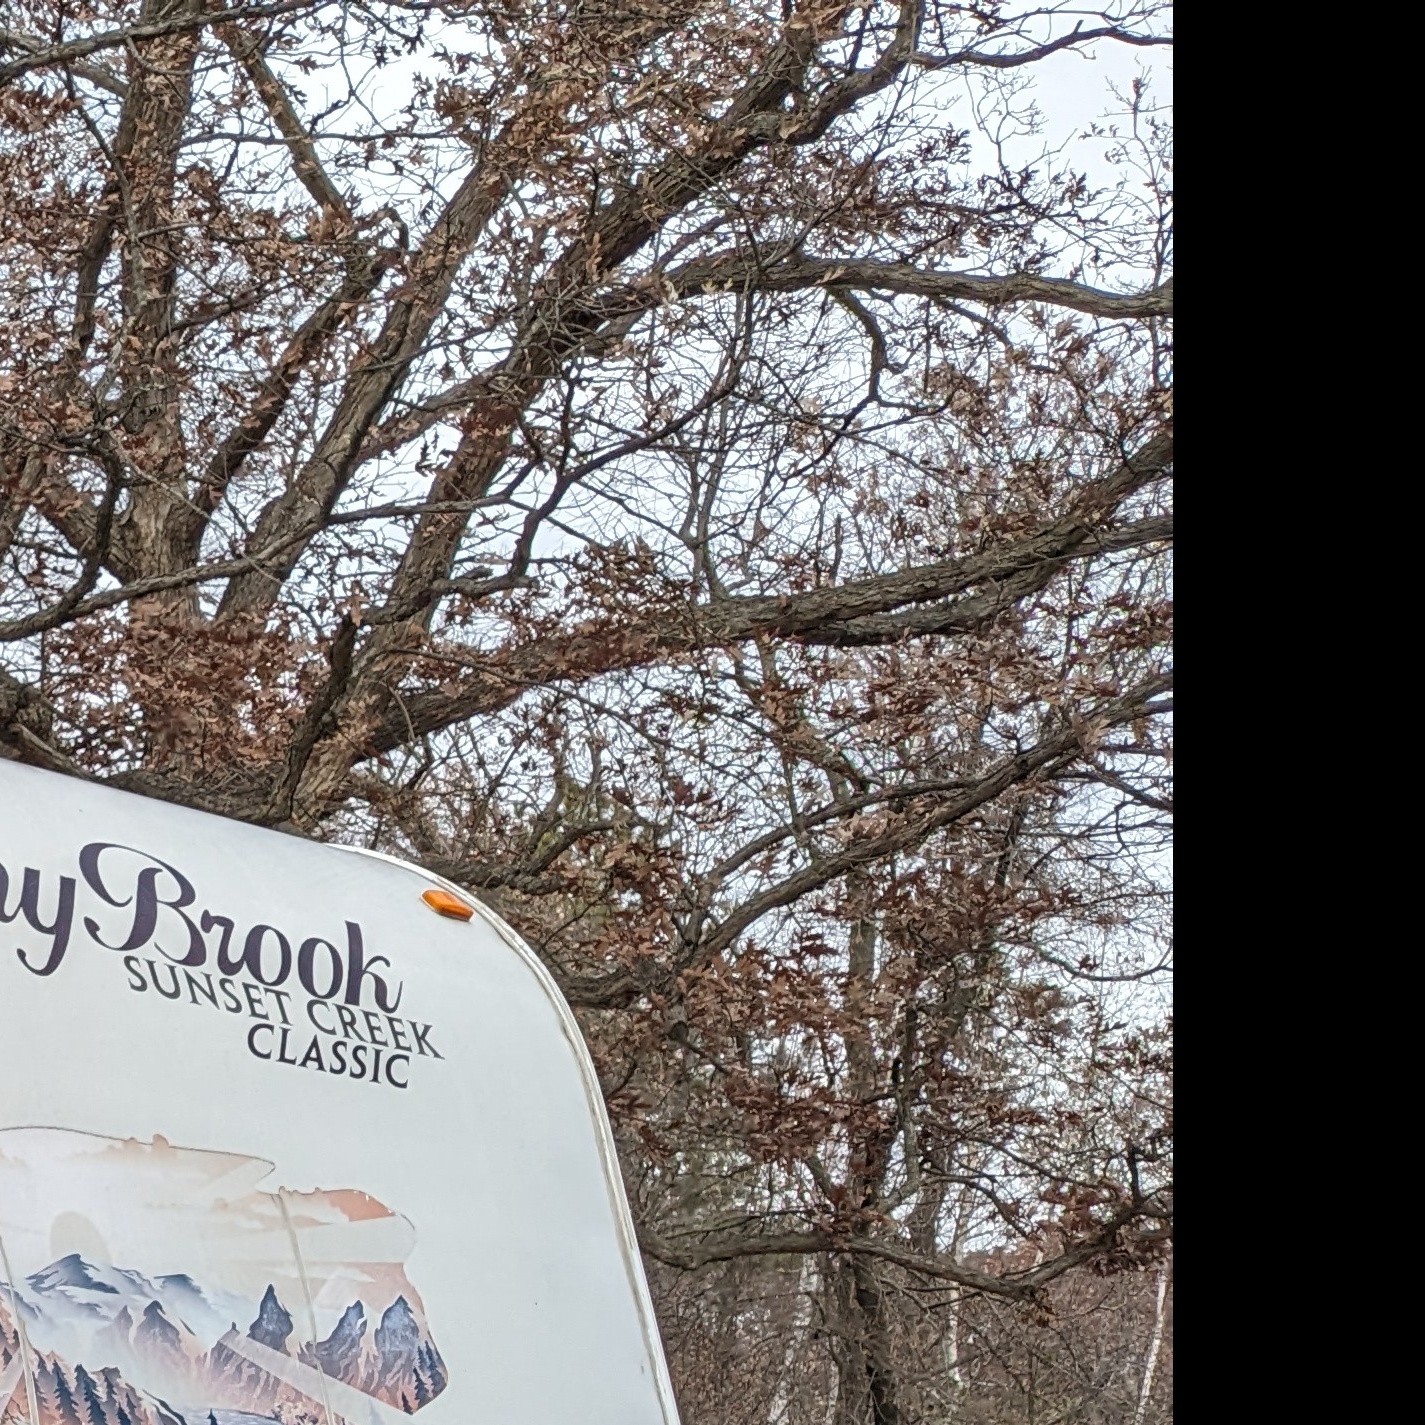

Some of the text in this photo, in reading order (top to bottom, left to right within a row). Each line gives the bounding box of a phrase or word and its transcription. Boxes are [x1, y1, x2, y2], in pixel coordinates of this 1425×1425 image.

[125, 954, 445, 1061] SUNSET CREEK
[247, 1022, 412, 1089] CLASSIC
